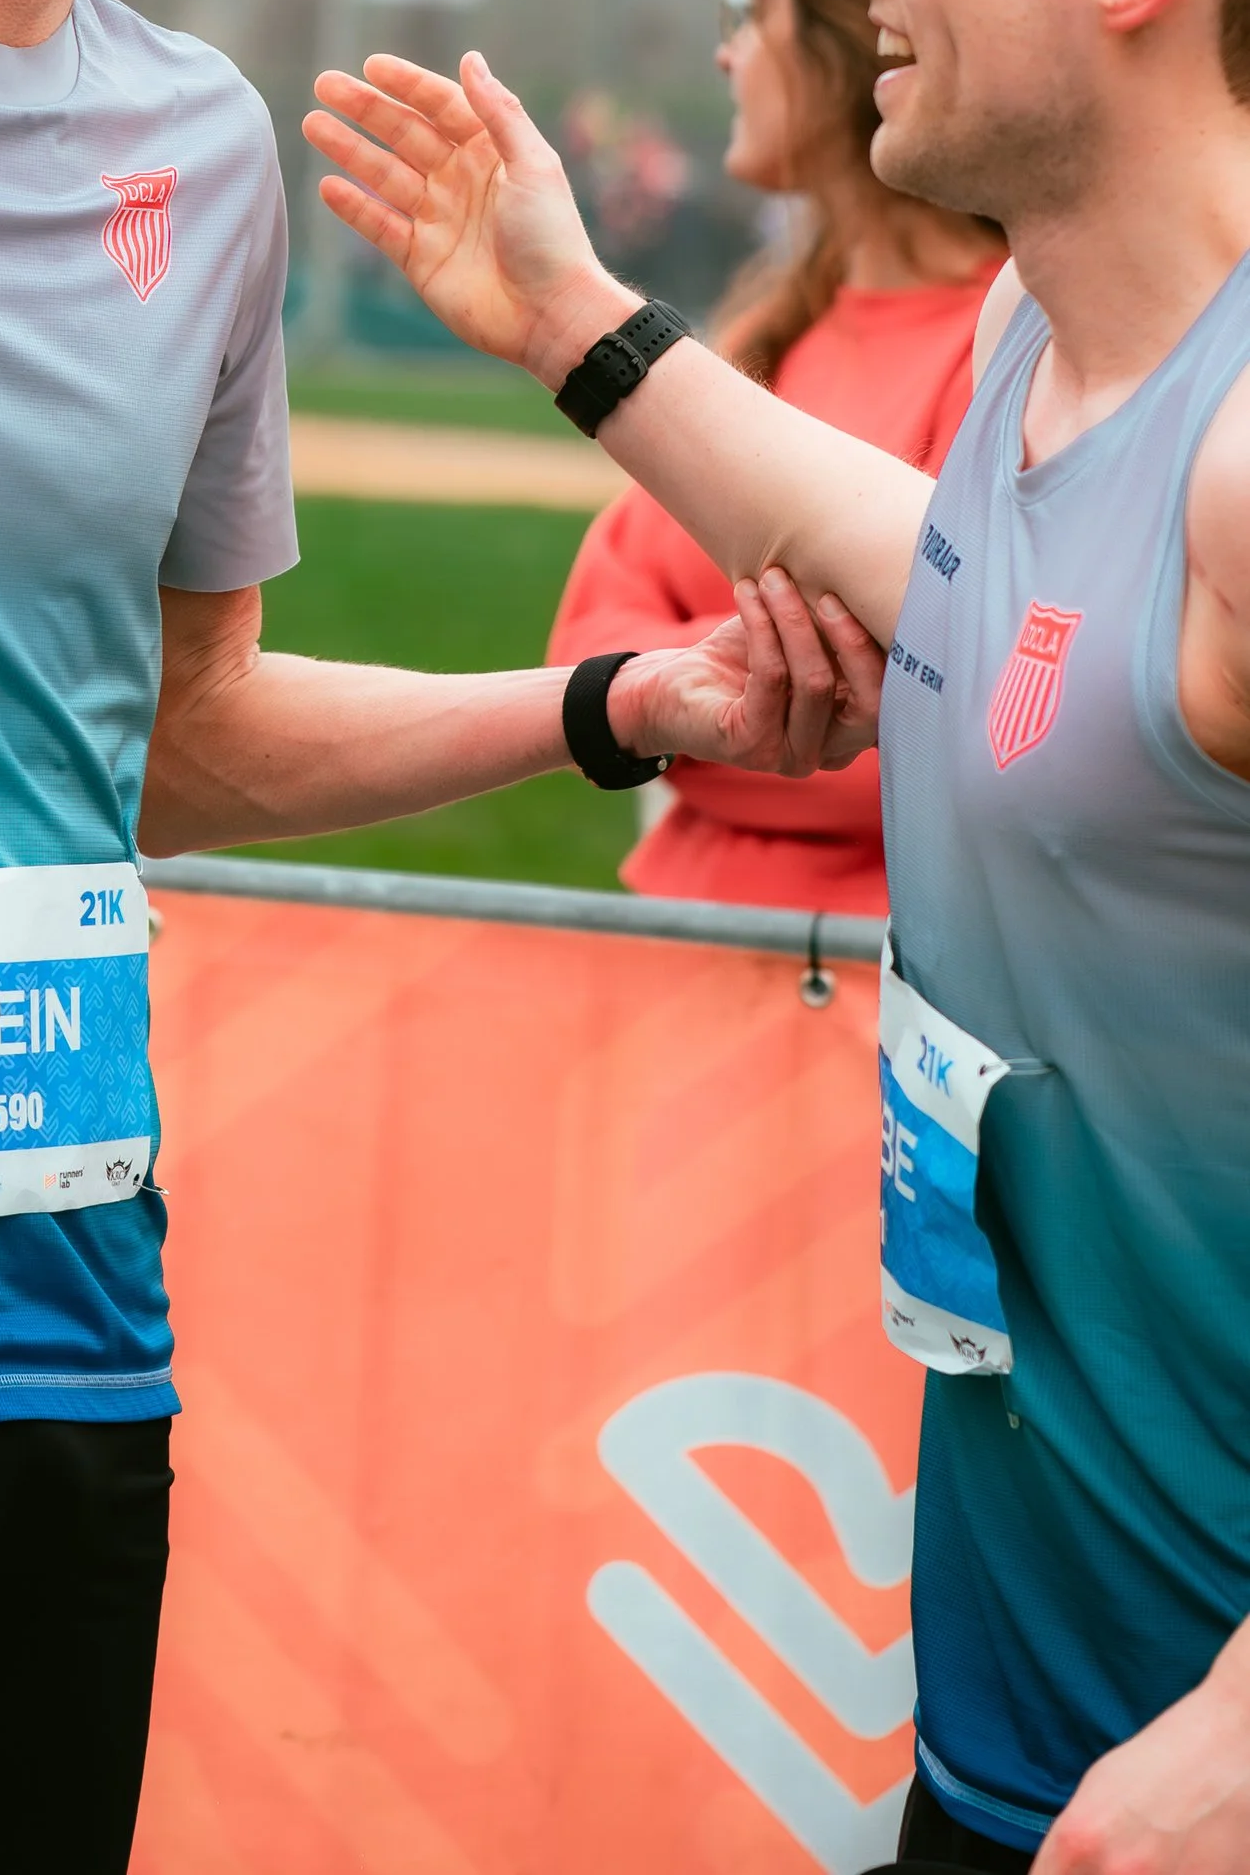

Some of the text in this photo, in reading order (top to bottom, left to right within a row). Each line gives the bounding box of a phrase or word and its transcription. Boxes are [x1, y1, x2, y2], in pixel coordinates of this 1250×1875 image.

[123, 182, 166, 203] DCLA
[903, 653, 921, 678] BY
[80, 889, 126, 926] 21K
[917, 1034, 954, 1099] 21K
[59, 1180, 71, 1189] lab
